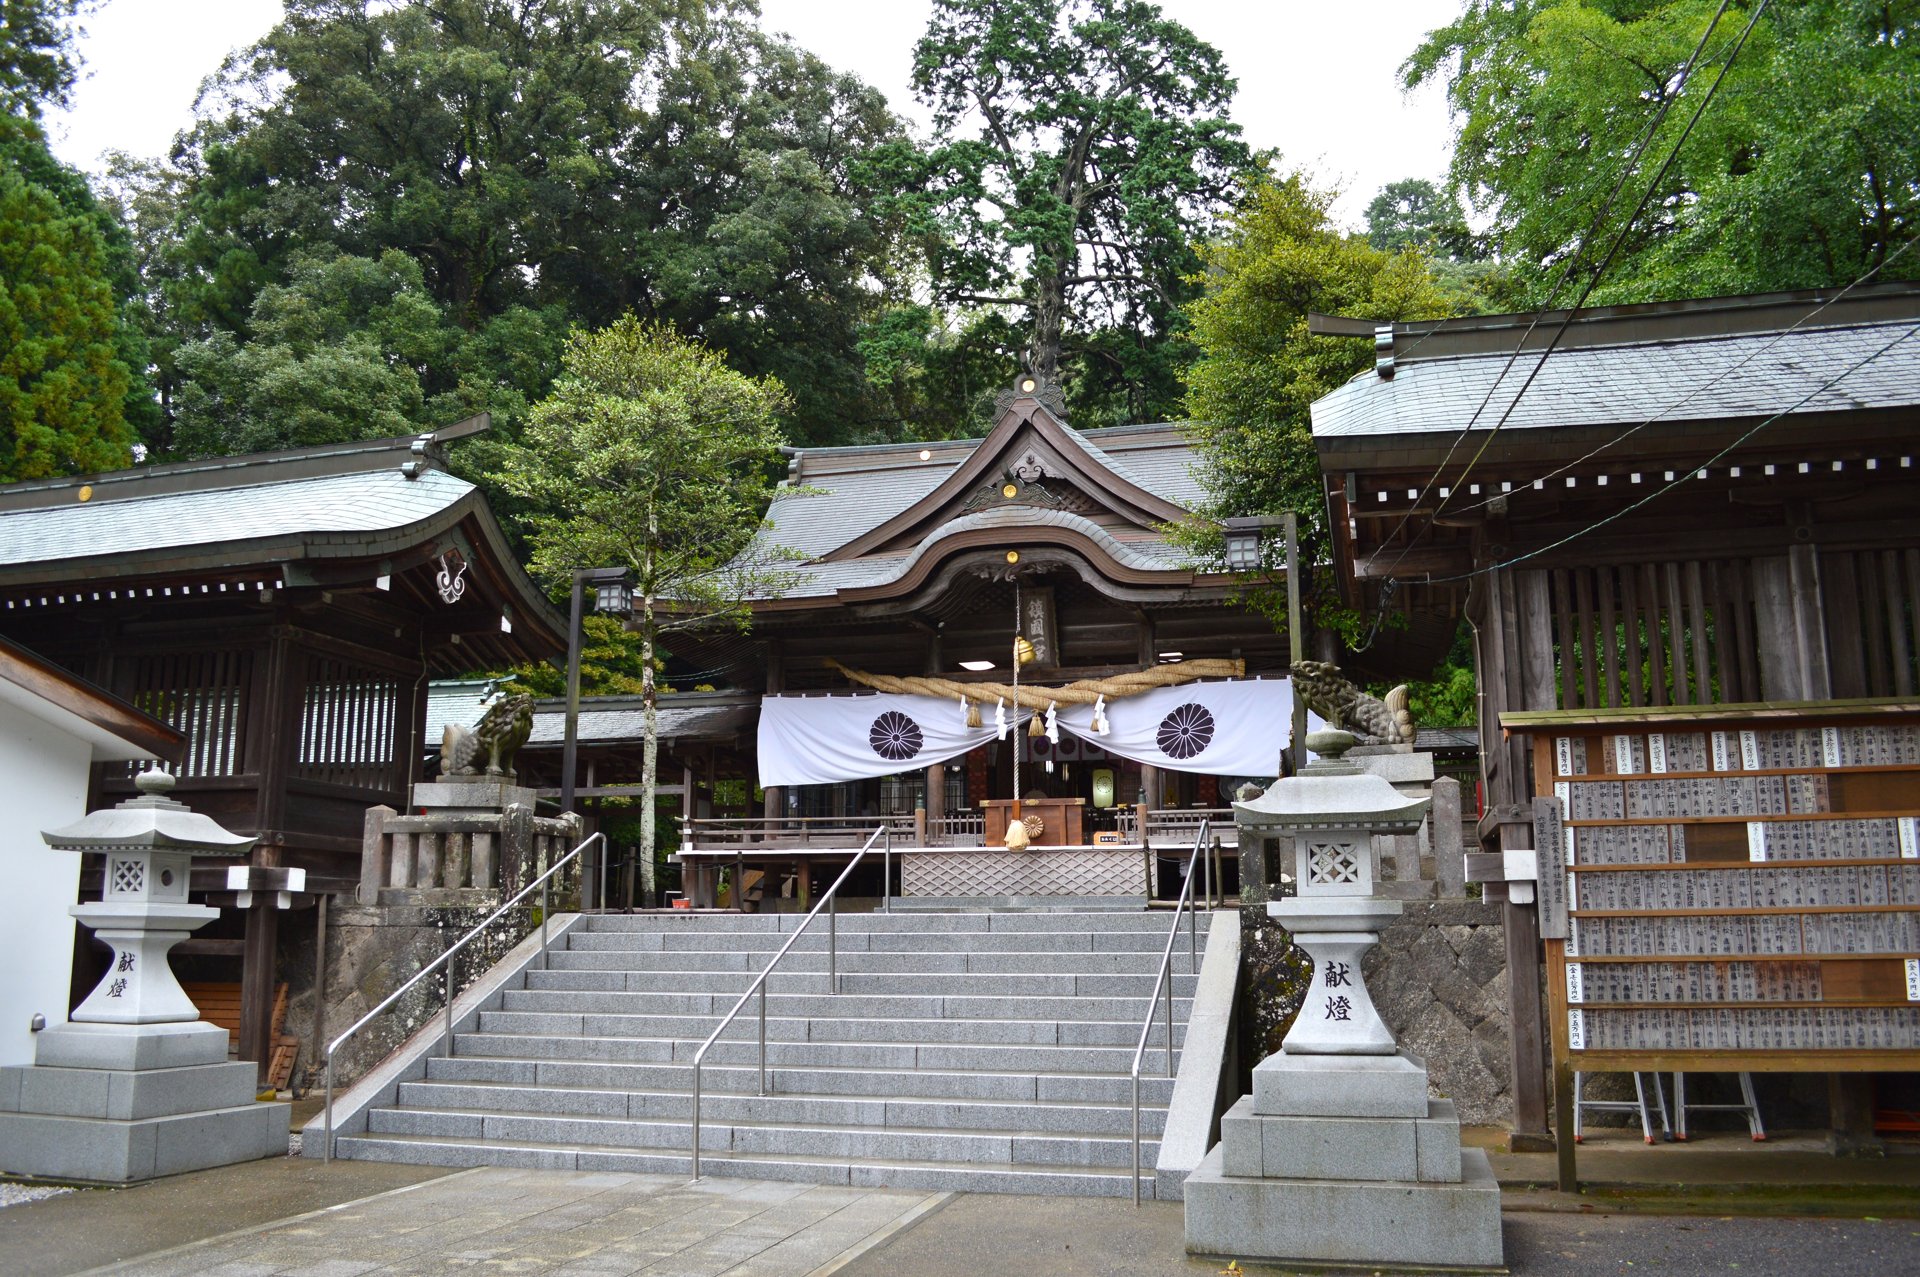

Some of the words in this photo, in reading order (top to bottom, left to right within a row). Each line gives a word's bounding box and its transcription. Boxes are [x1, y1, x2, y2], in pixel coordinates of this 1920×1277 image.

[106, 952, 136, 998] 献燈
[1324, 961, 1352, 1023] 献燈
[1569, 963, 1579, 1001] 一金壱拾万円也
[1571, 1008, 1581, 1046] 一金五万円也
